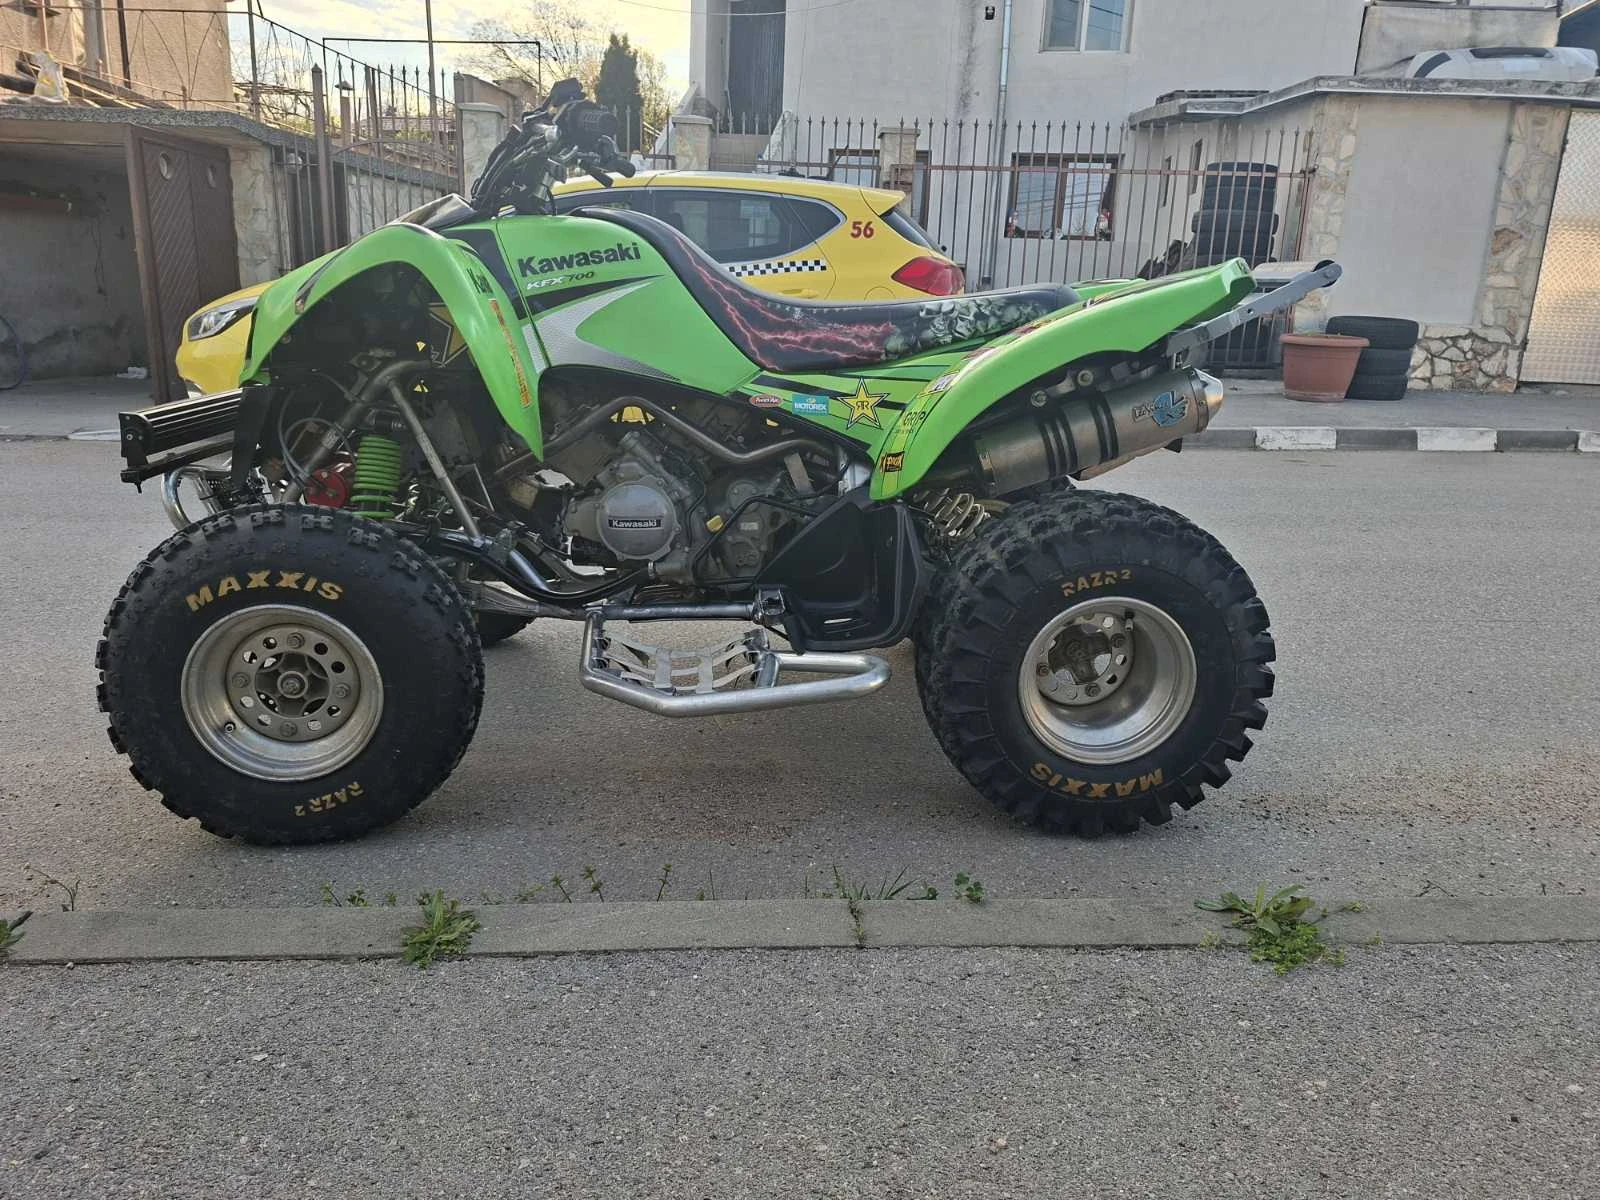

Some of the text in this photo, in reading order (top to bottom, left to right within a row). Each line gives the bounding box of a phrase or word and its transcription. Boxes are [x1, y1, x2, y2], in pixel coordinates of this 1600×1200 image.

[850, 220, 875, 239] 56
[517, 241, 642, 278] Kawasaki
[794, 402, 827, 411] MOTOREX
[612, 519, 658, 528] Kawasaki
[185, 569, 344, 613] MAXXIS
[1029, 762, 1165, 798] MAXXIS
